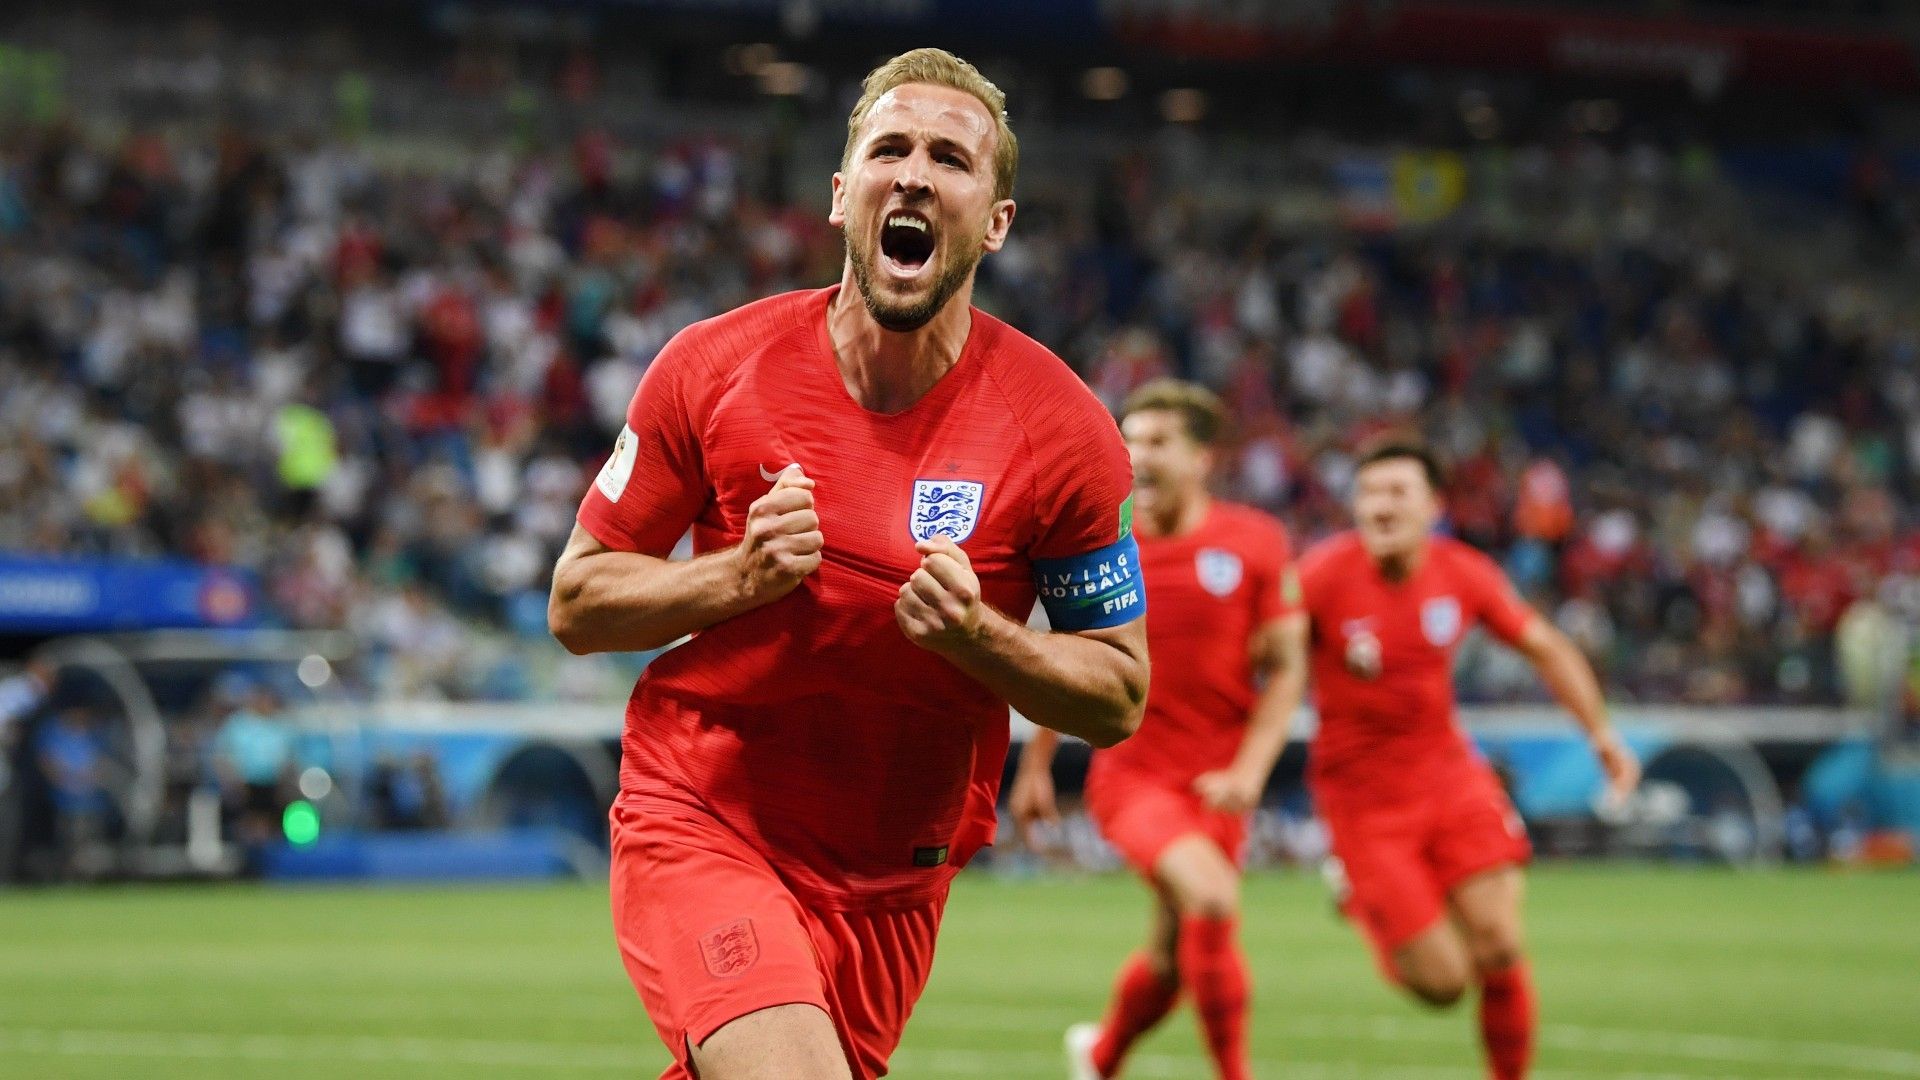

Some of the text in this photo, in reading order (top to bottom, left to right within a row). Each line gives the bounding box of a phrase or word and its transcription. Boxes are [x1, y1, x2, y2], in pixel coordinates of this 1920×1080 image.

[1042, 567, 1131, 598] OOTBALL
[1043, 553, 1128, 584] IVING
[1103, 589, 1139, 615] FIFA
